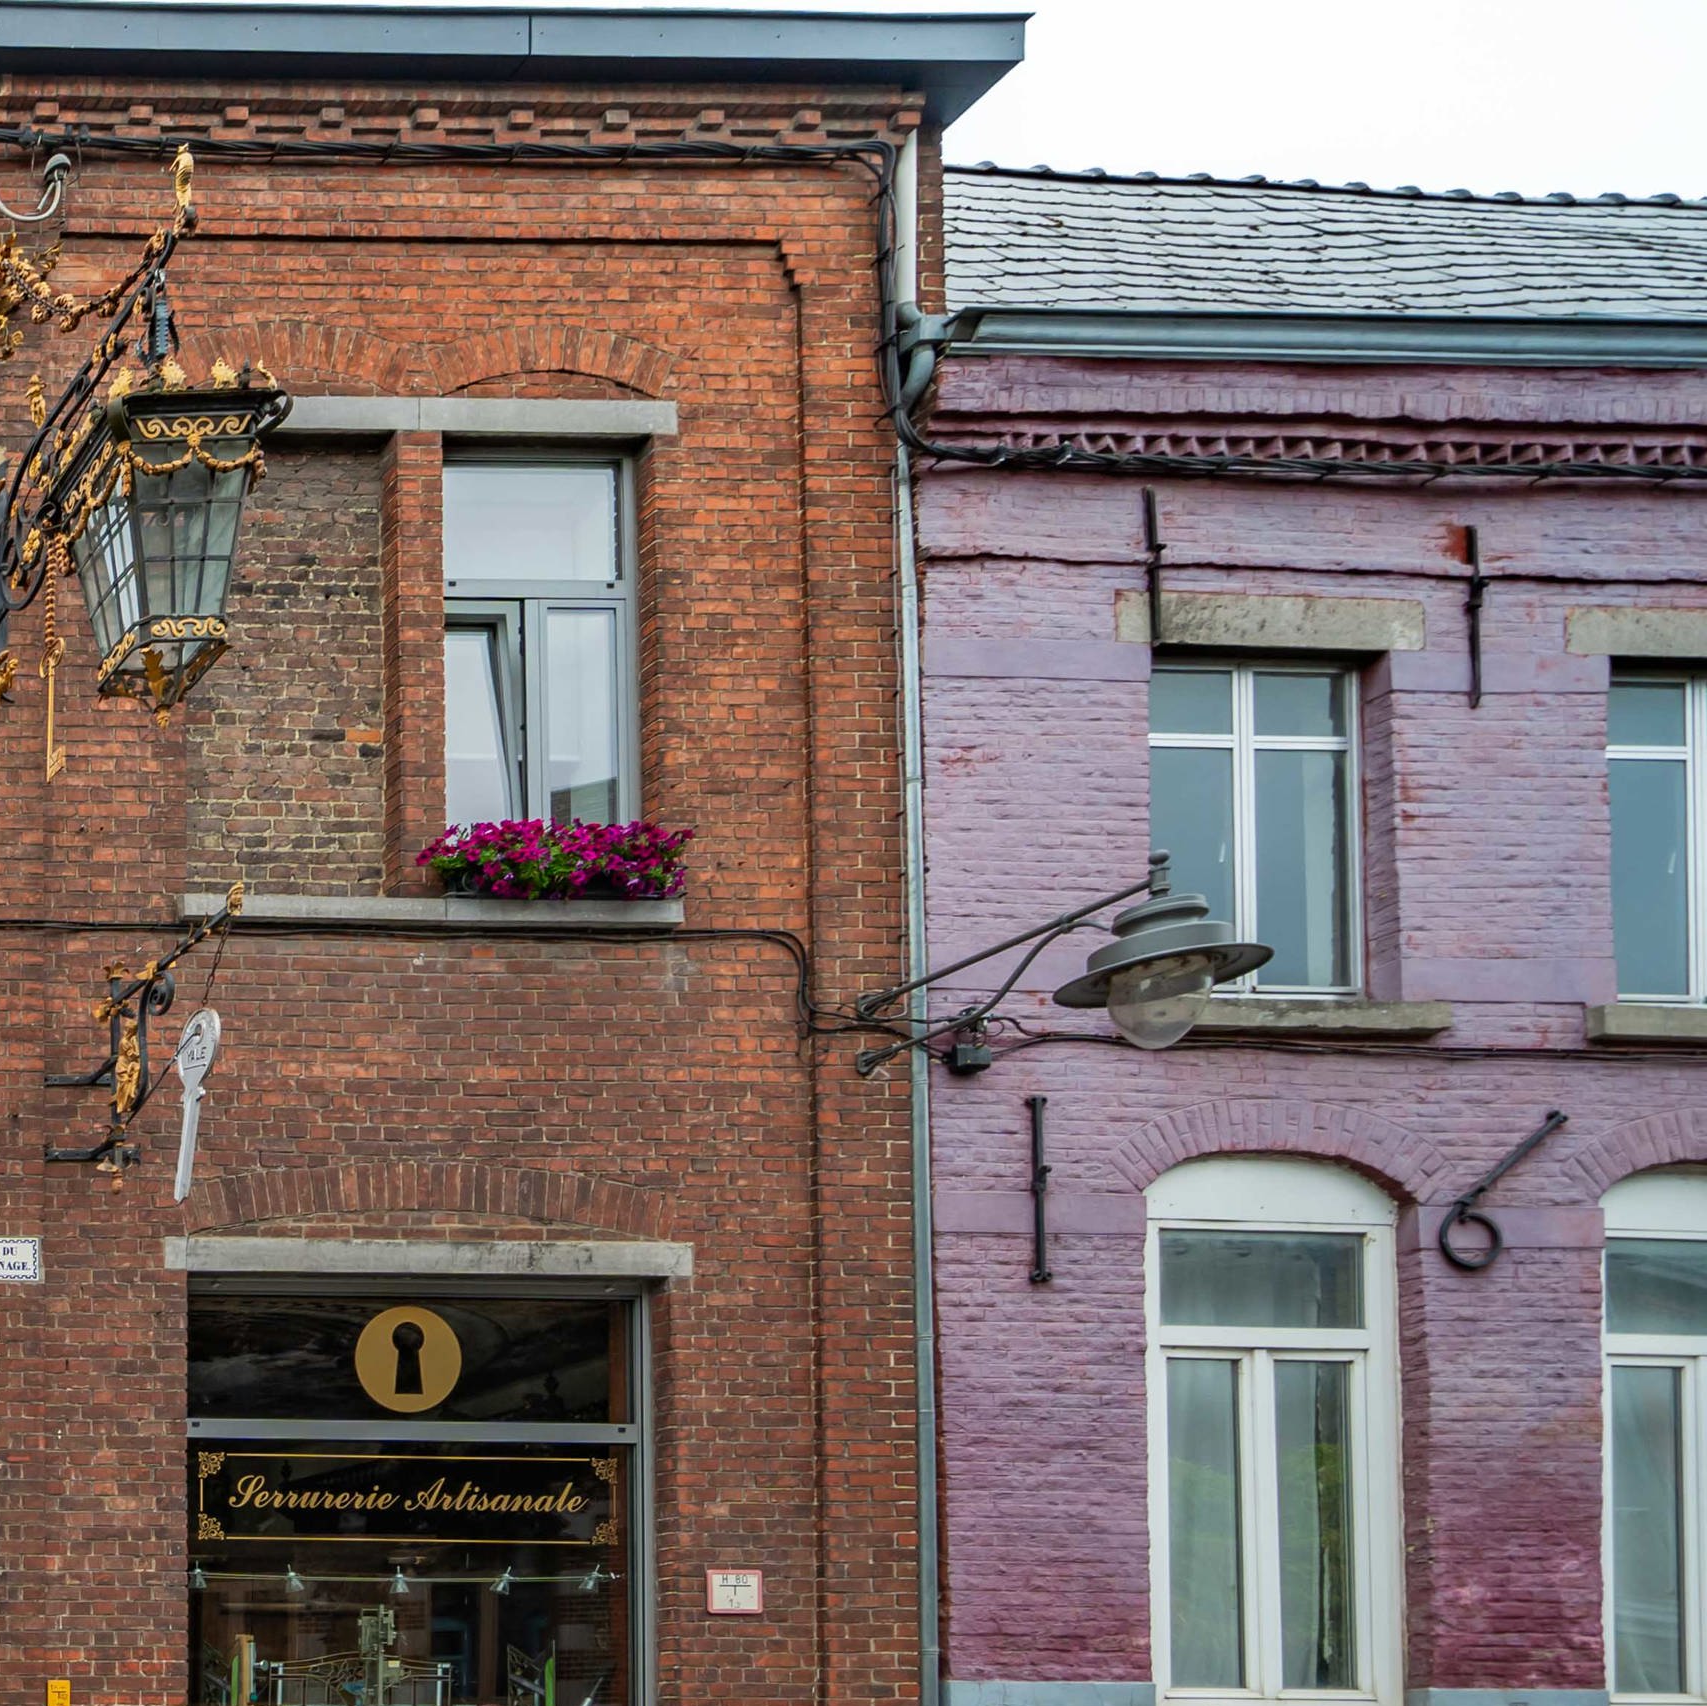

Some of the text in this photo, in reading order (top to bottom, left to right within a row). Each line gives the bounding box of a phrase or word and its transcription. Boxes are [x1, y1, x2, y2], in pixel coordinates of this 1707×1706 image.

[187, 1046, 207, 1064] YALE
[2, 1246, 18, 1256] DU
[228, 1475, 589, 1512] Serrurerie Artisanale
[722, 1574, 748, 1584] H 80
